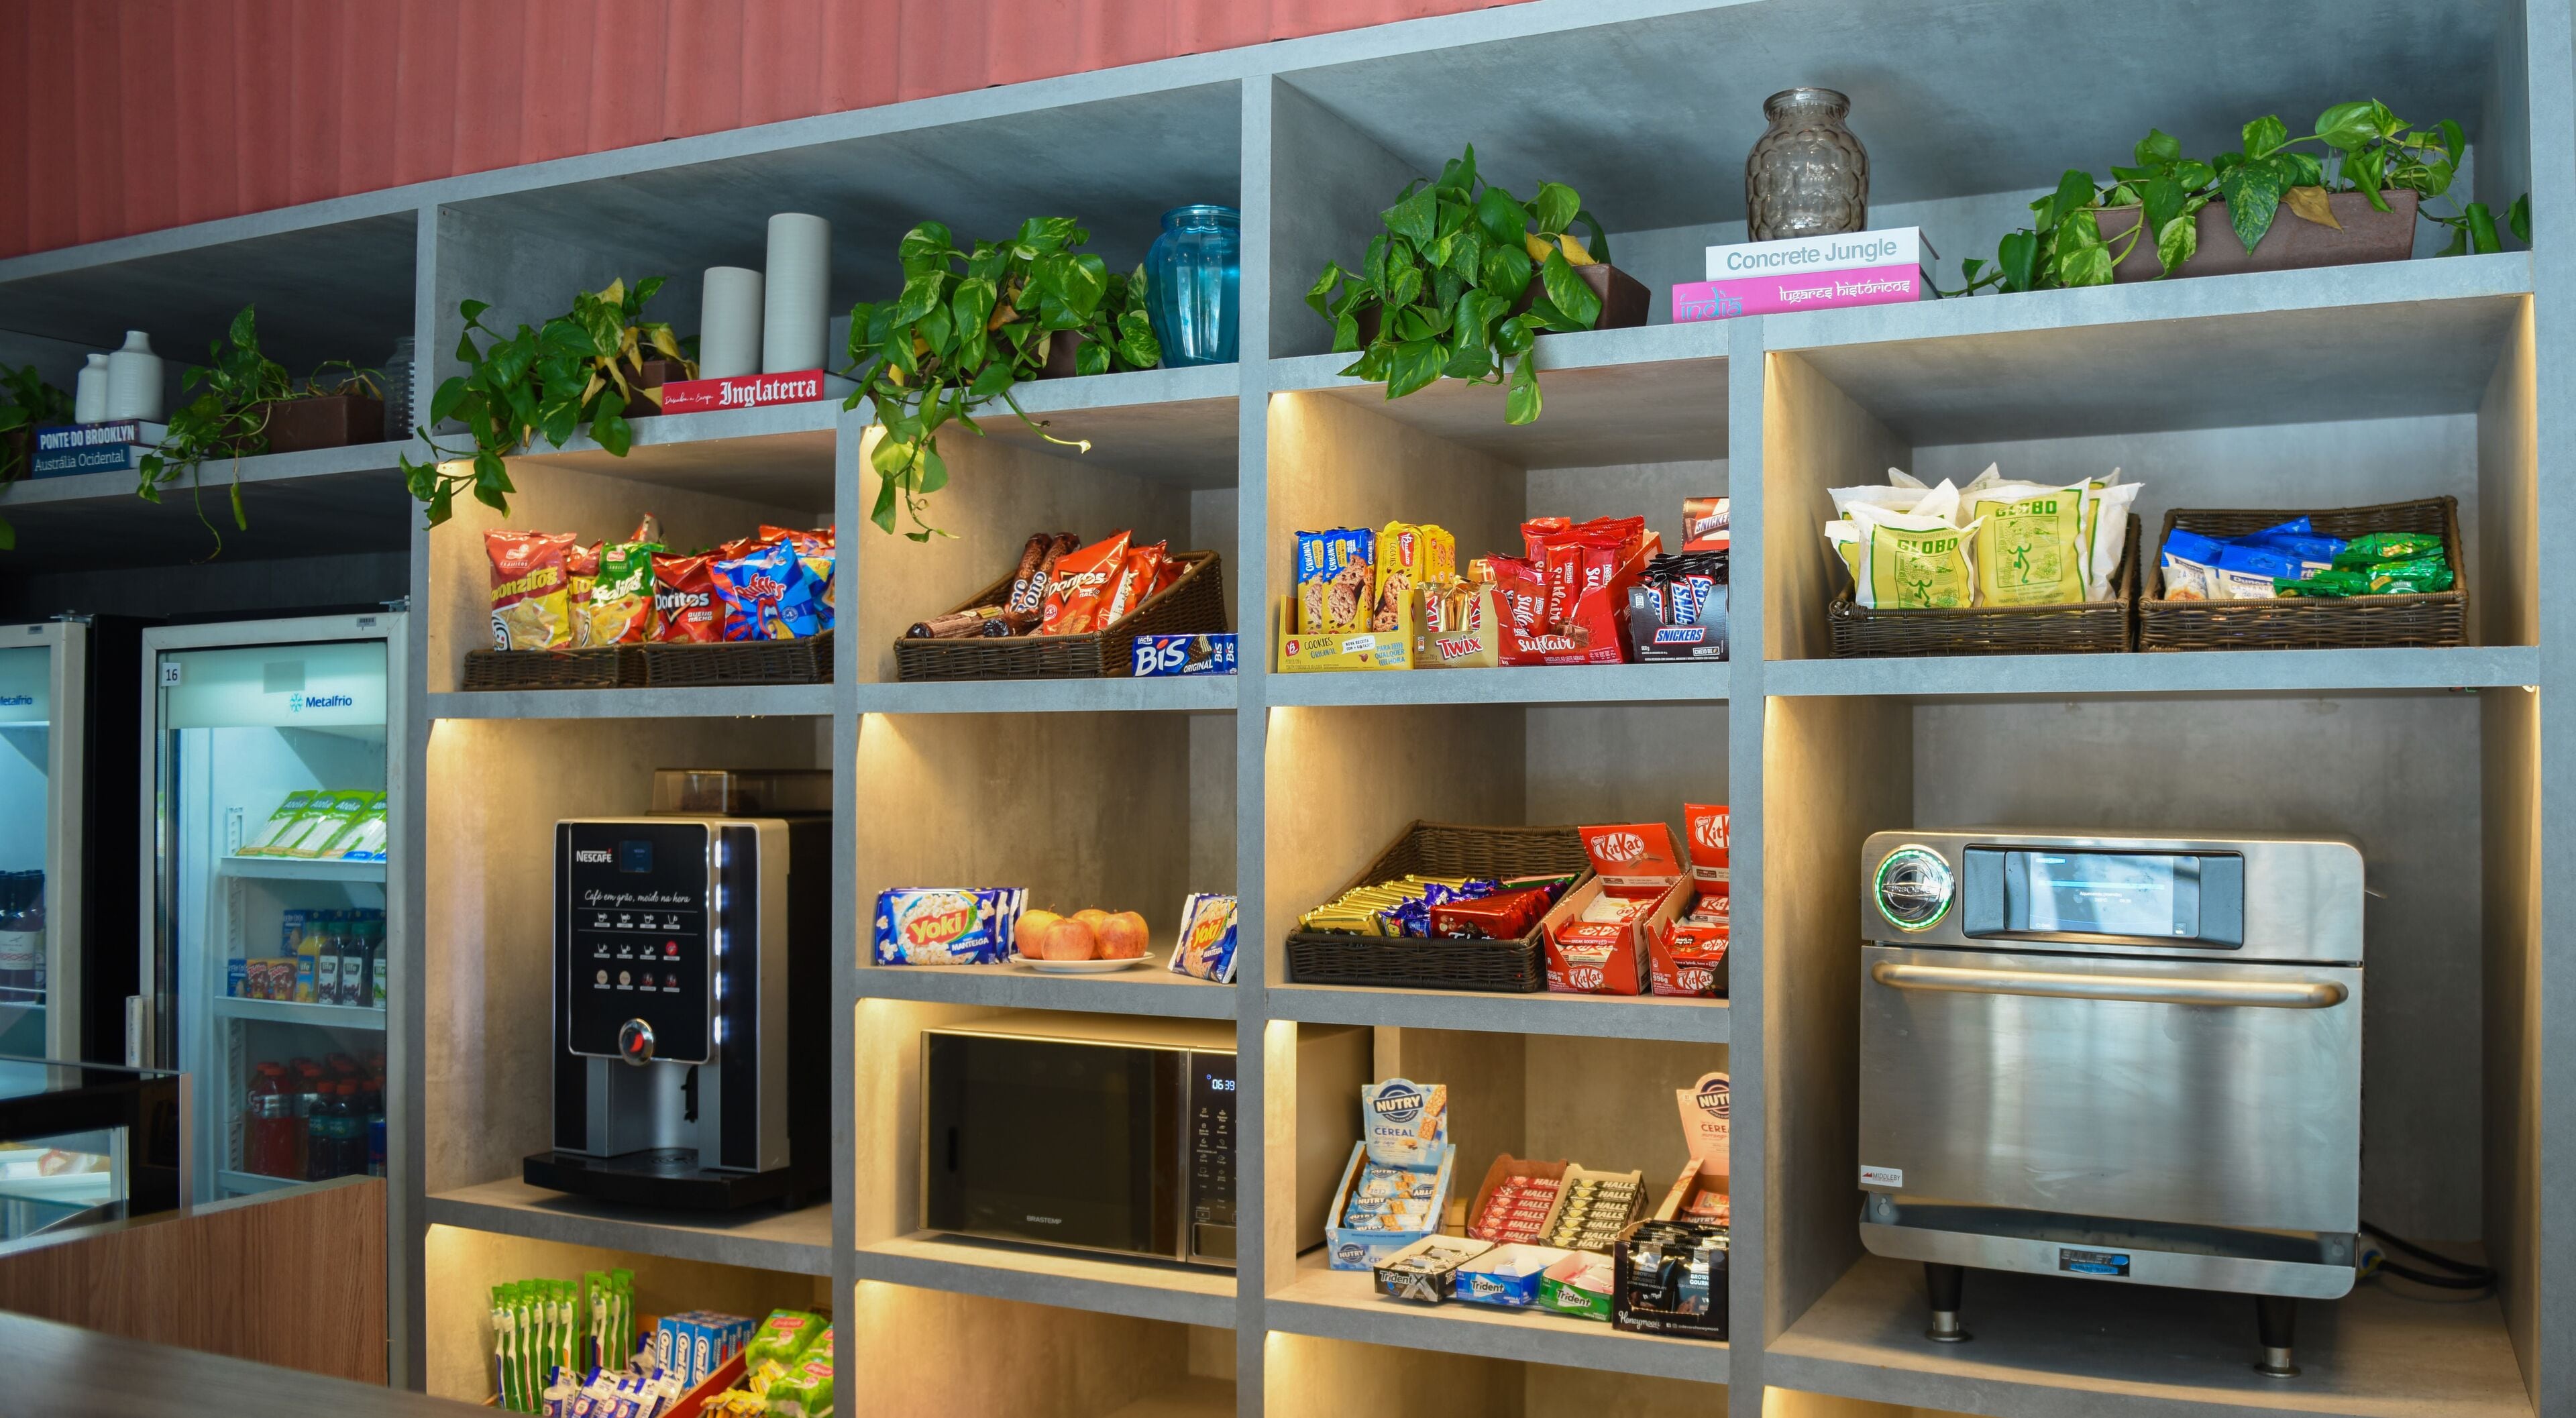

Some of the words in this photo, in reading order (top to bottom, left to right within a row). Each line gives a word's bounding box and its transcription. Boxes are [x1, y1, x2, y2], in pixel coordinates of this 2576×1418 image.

[1727, 246, 1821, 271] Concrete
[1825, 237, 1897, 263] Jungle
[1778, 286, 1833, 305] lugares
[719, 378, 817, 407] Inglaterra
[40, 432, 69, 450] PONTE
[70, 431, 84, 447] DO
[85, 425, 135, 445] BROOKLYN
[35, 455, 76, 471] Austrália
[78, 449, 125, 467] Ocidental
[1996, 500, 2057, 518] GLOBO
[1696, 514, 1729, 533] SNICKE
[1400, 533, 1413, 565] Bauducco
[1897, 537, 1958, 554] GLOBO
[1303, 539, 1315, 571] ORIGINAL
[1326, 539, 1338, 571] ORIGINAL
[1564, 562, 1574, 584] Nestlé
[491, 566, 558, 602] aconzitos
[735, 573, 787, 602] Ruffles
[1048, 571, 1109, 597] Doritos
[655, 592, 710, 611] Doritos
[1657, 629, 1704, 642] SNICKERS
[1304, 637, 1334, 651] COOKIES
[1436, 635, 1483, 659] Twix
[1518, 637, 1575, 654] suflair
[1310, 649, 1337, 659] ORIGINAL
[1375, 649, 1405, 659] QUALQUER
[1183, 659, 1213, 673] ORIGINAL
[165, 668, 178, 681] 16
[305, 694, 353, 708] Metalfrio
[576, 848, 612, 863] NESCAFÉ
[585, 889, 602, 906] Café
[673, 891, 692, 903] hora
[951, 937, 989, 951] MANTEIGA
[300, 963, 310, 972] life
[1376, 1095, 1421, 1112] NUTRY
[1375, 1128, 1415, 1137] CEREAL
[1873, 1172, 1900, 1181] MIDDLEBY
[1603, 1181, 1635, 1189] HALLS
[1522, 1189, 1554, 1199] HALLS
[1598, 1191, 1632, 1200] HALLS
[1517, 1200, 1550, 1209] HALLS
[1594, 1201, 1629, 1211] HALLS
[1026, 1215, 1062, 1225] BRASTEMP
[1513, 1210, 1544, 1219] HALLS
[1591, 1211, 1624, 1219] HALLS
[1508, 1221, 1541, 1230] HALLS
[1587, 1221, 1621, 1230] HALLS
[1338, 1250, 1364, 1258] NUTRY
[1380, 1270, 1413, 1285] Trident
[1471, 1280, 1504, 1293] Trident
[1557, 1289, 1591, 1307] Trident
[1618, 1310, 1662, 1330] Honeymoon
